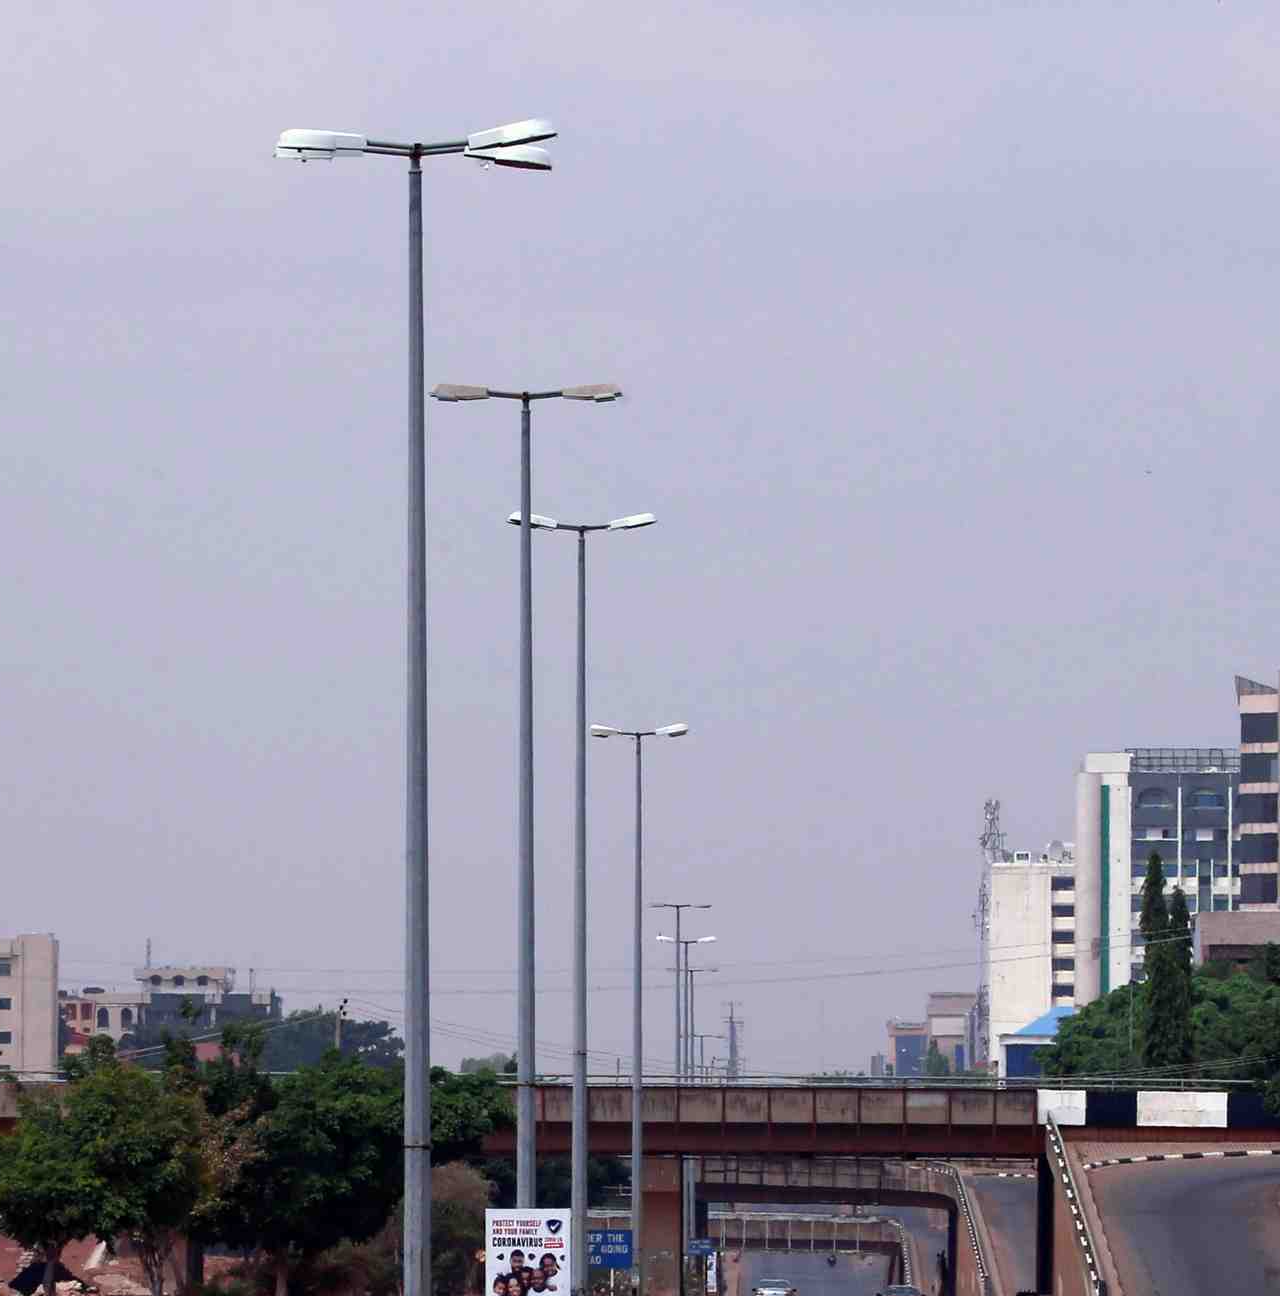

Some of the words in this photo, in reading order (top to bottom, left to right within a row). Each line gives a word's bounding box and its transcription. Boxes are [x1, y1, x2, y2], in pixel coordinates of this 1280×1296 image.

[492, 1237, 543, 1248] CORONAVIRUS
[607, 1233, 625, 1243] THE
[600, 1244, 628, 1254] GOING
